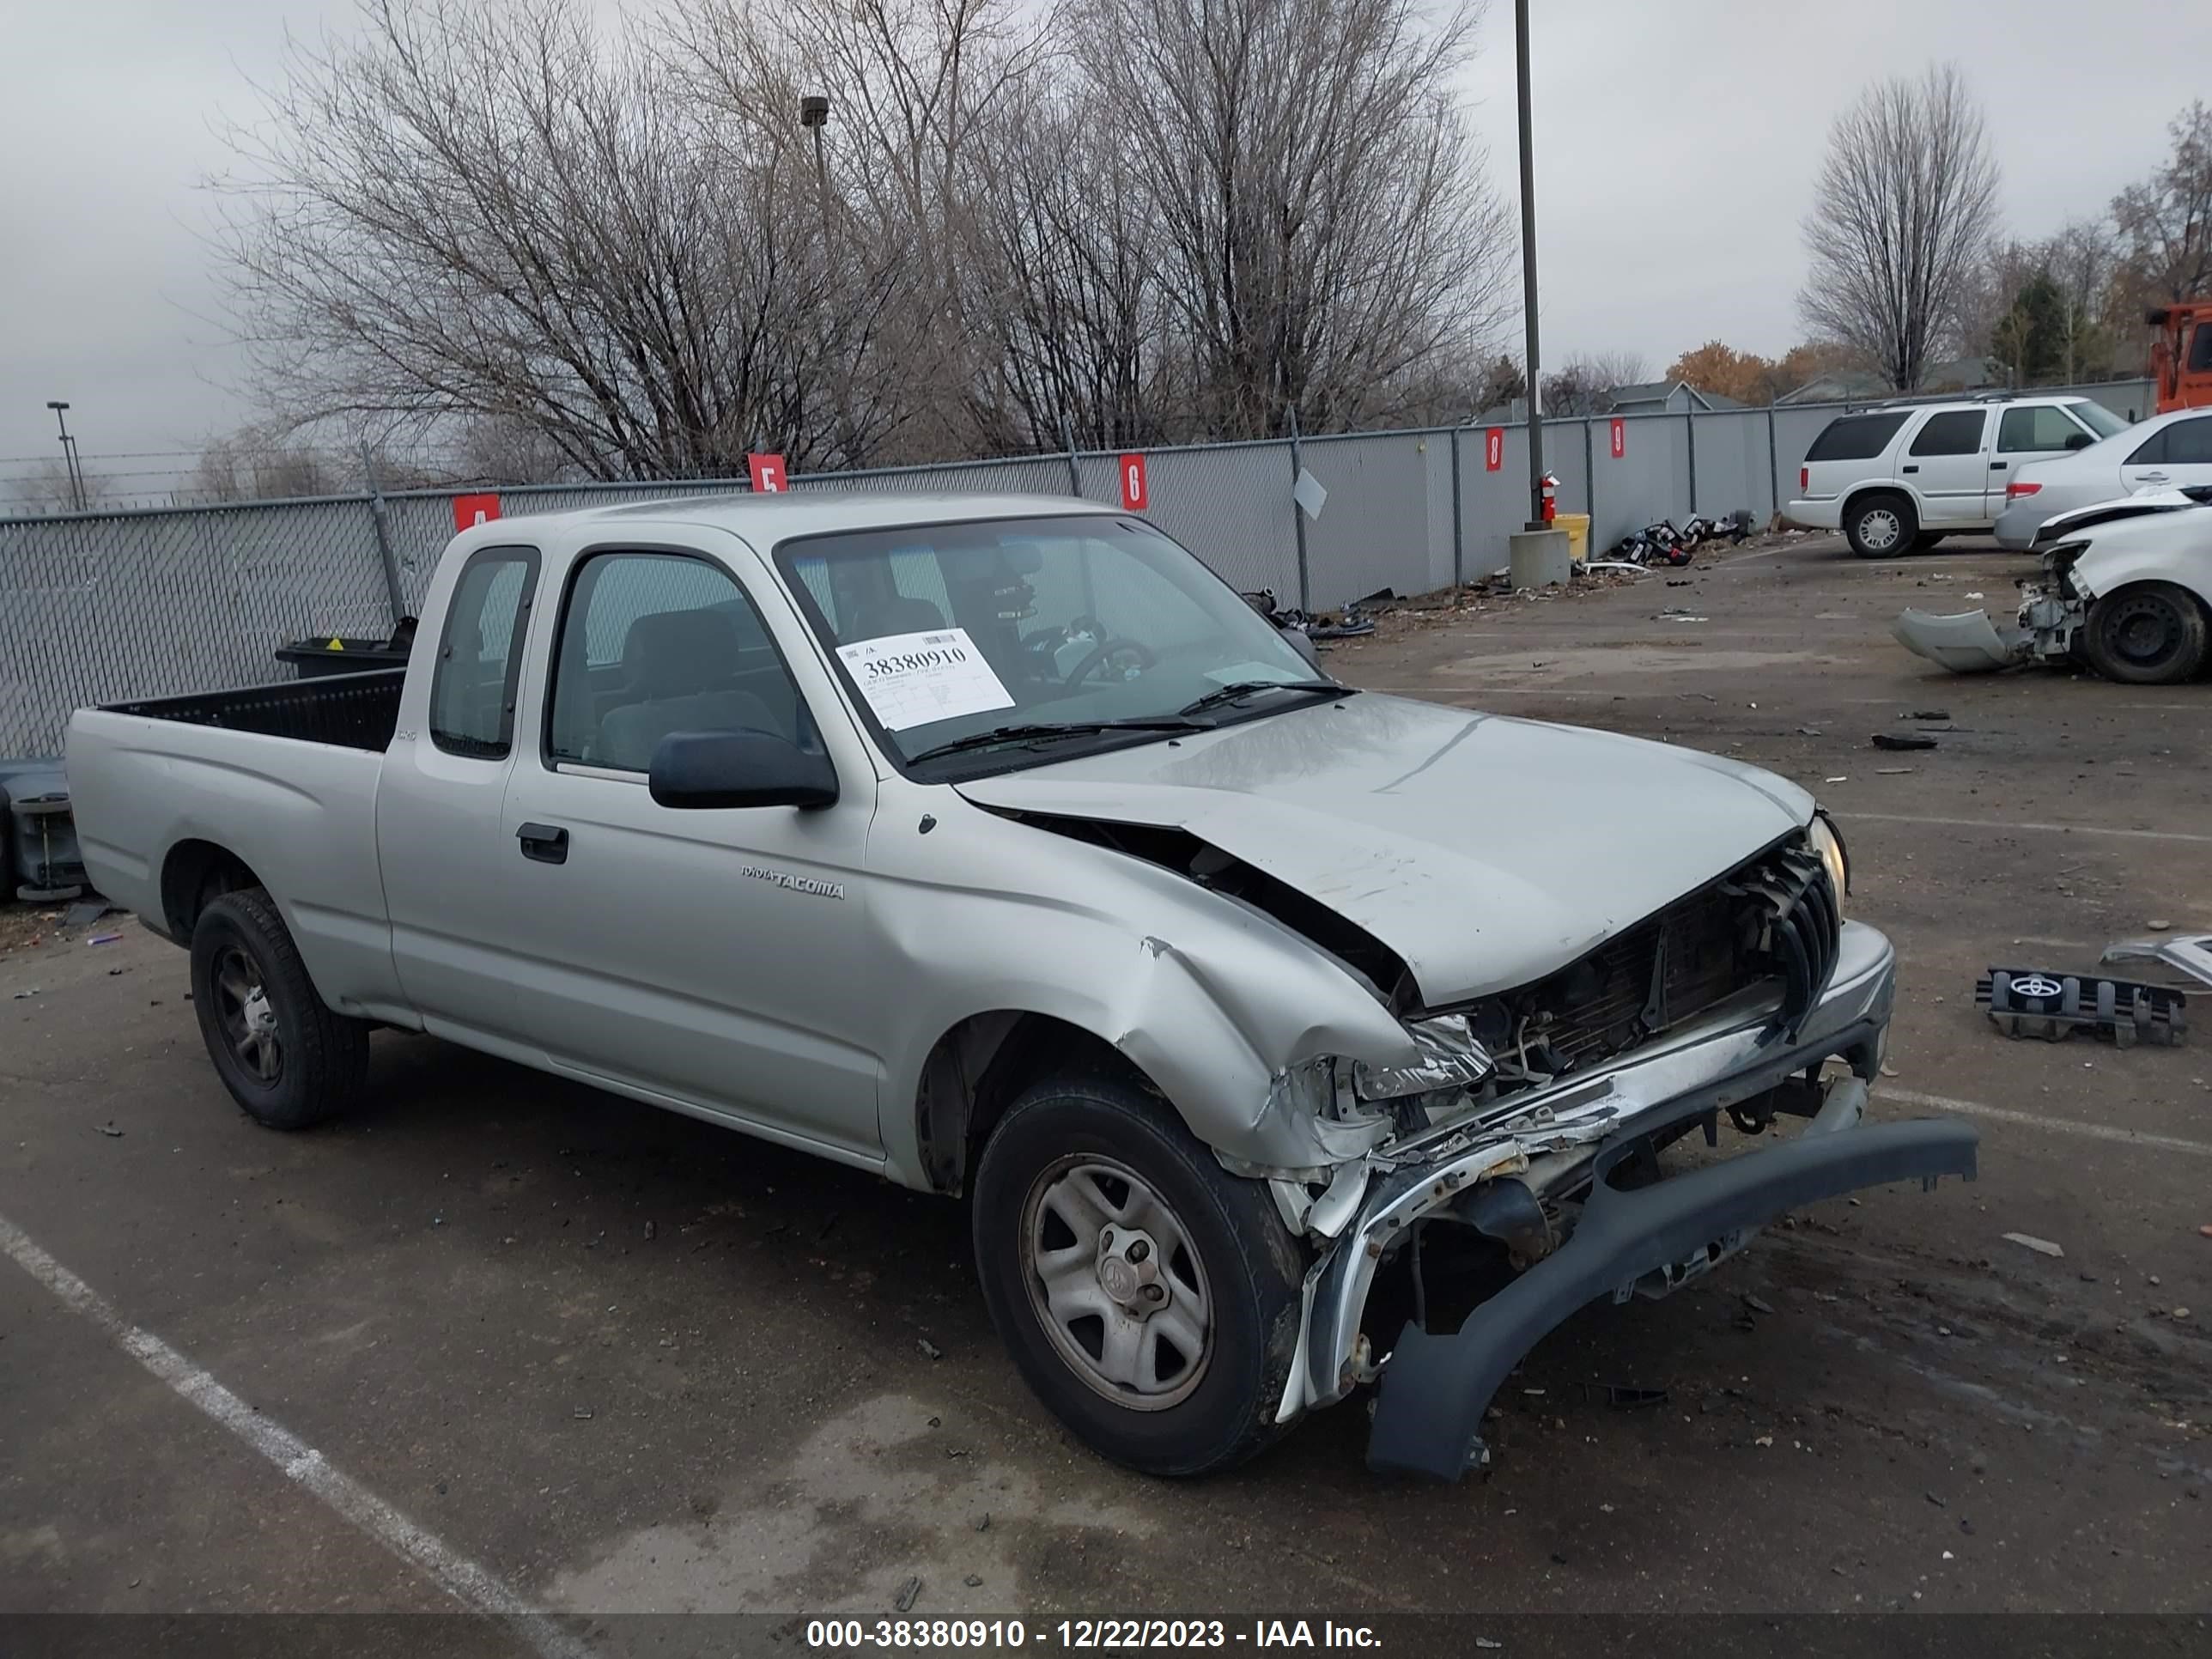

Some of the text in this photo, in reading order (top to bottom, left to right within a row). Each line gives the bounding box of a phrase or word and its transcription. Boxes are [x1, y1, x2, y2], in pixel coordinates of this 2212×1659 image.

[1491, 436, 1498, 465] 8
[1128, 465, 1140, 501] 6
[863, 647, 967, 679] 38380910
[775, 872, 845, 901] TACOMA
